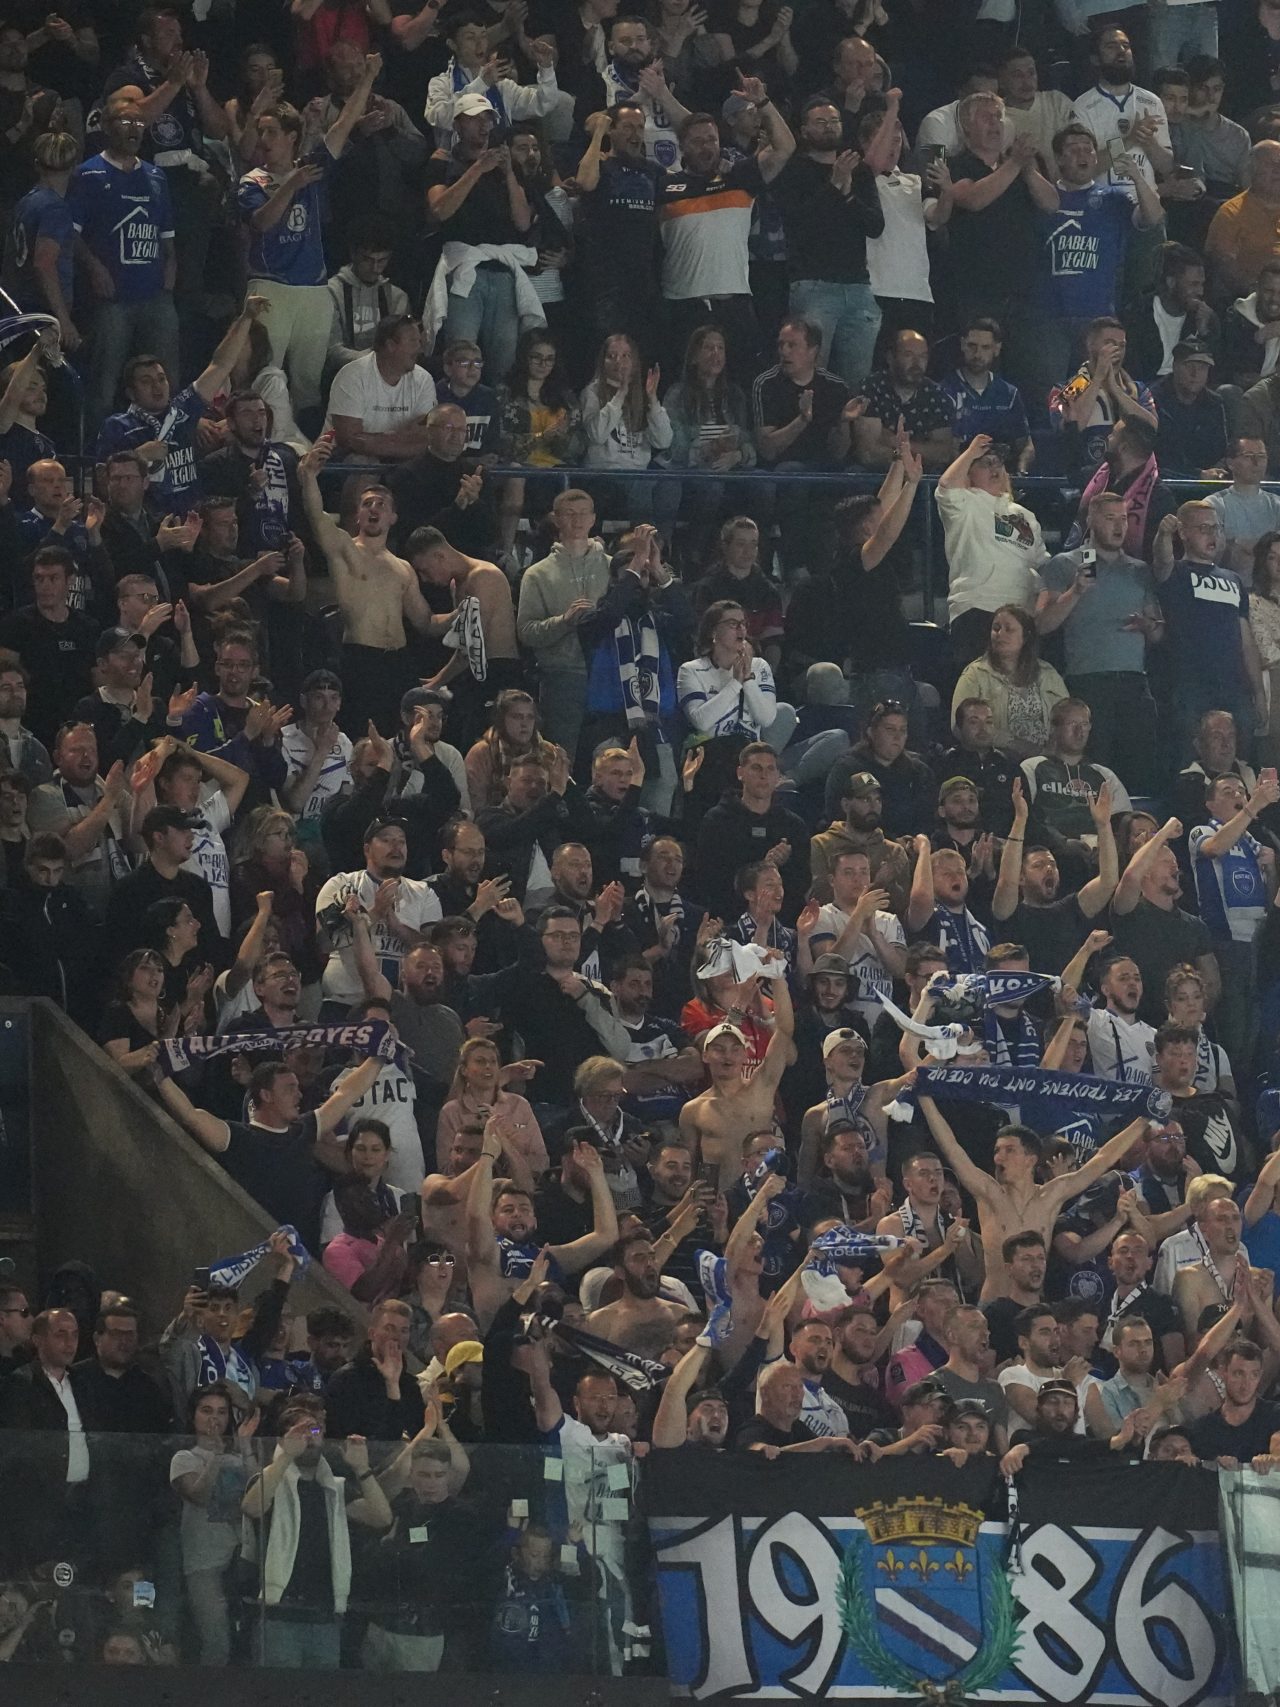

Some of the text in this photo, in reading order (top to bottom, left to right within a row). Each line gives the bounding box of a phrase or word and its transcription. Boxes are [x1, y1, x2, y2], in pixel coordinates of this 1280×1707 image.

[1057, 235, 1099, 252] BABEAU
[1061, 252, 1099, 270] SEGUIN
[978, 1072, 1000, 1088] DU
[1002, 1075, 1034, 1092] ONT
[1038, 1078, 1110, 1100] TROYENS
[1112, 1087, 1143, 1103] LES
